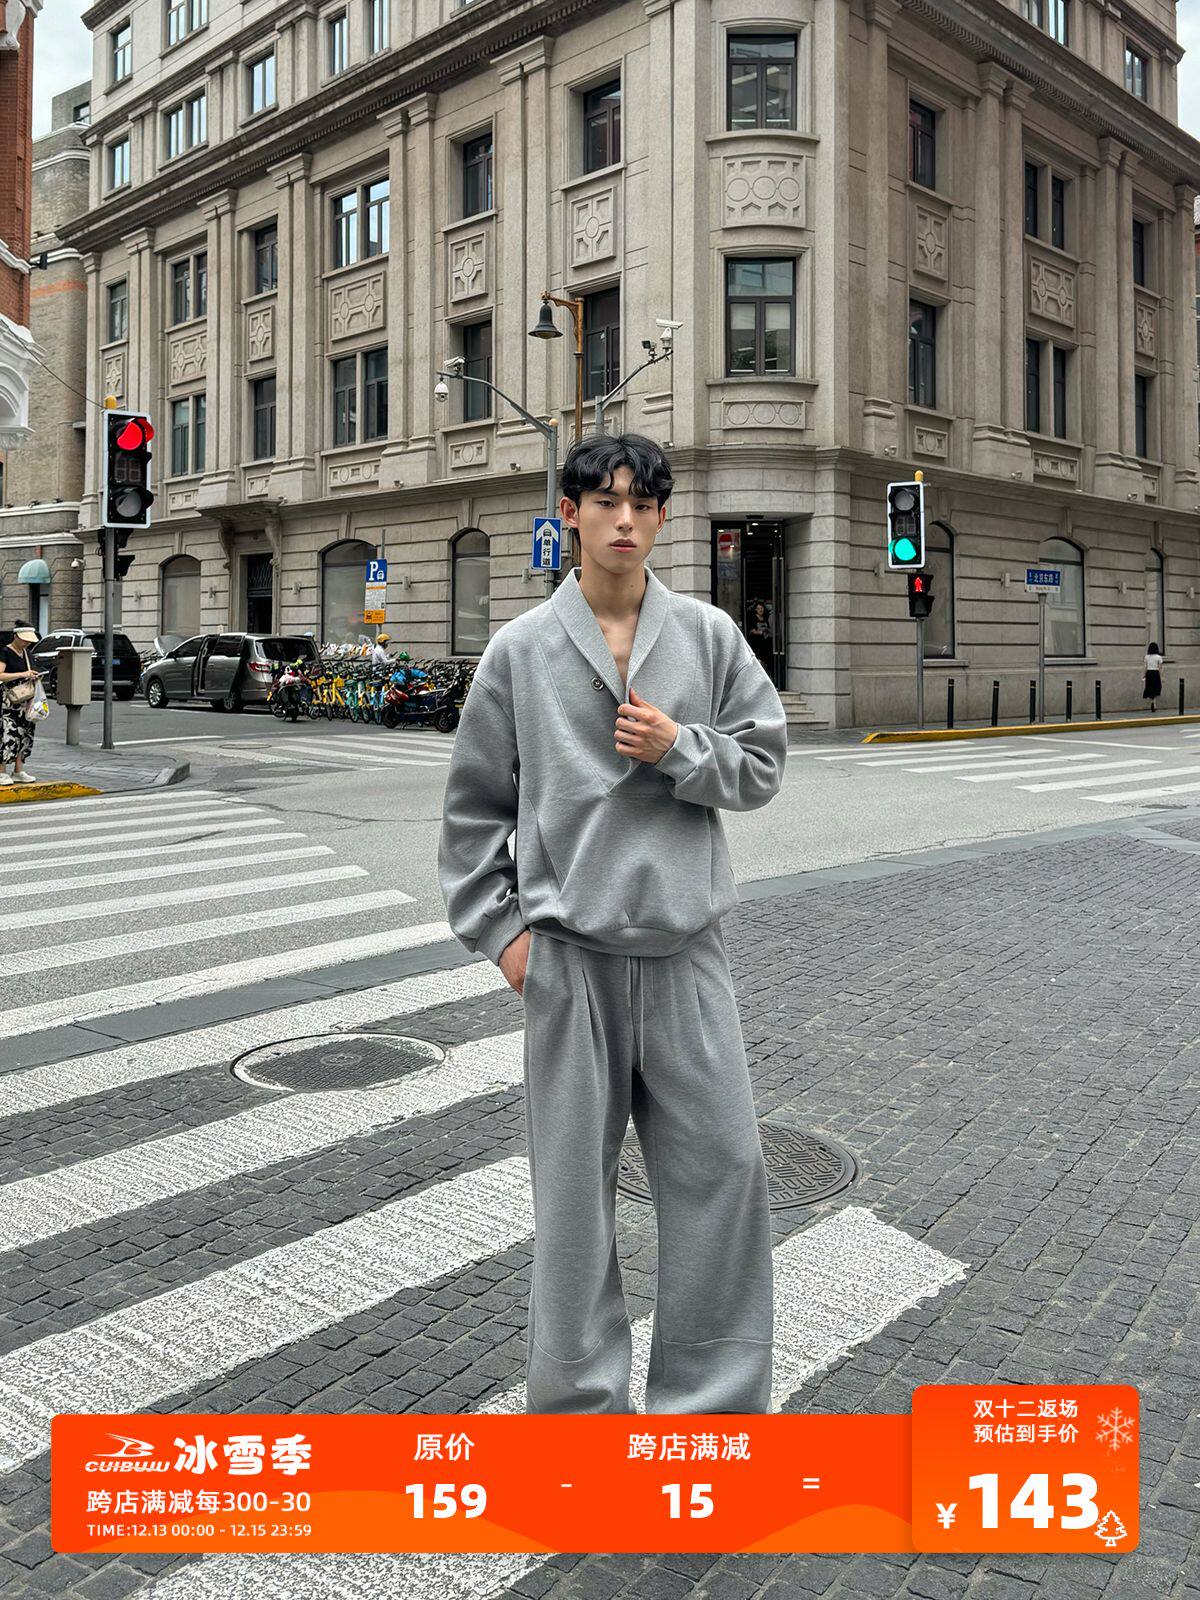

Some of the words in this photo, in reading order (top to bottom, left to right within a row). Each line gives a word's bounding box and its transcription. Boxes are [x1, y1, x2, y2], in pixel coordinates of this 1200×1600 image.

[542, 539, 551, 565] 单行道
[368, 561, 379, 581] P
